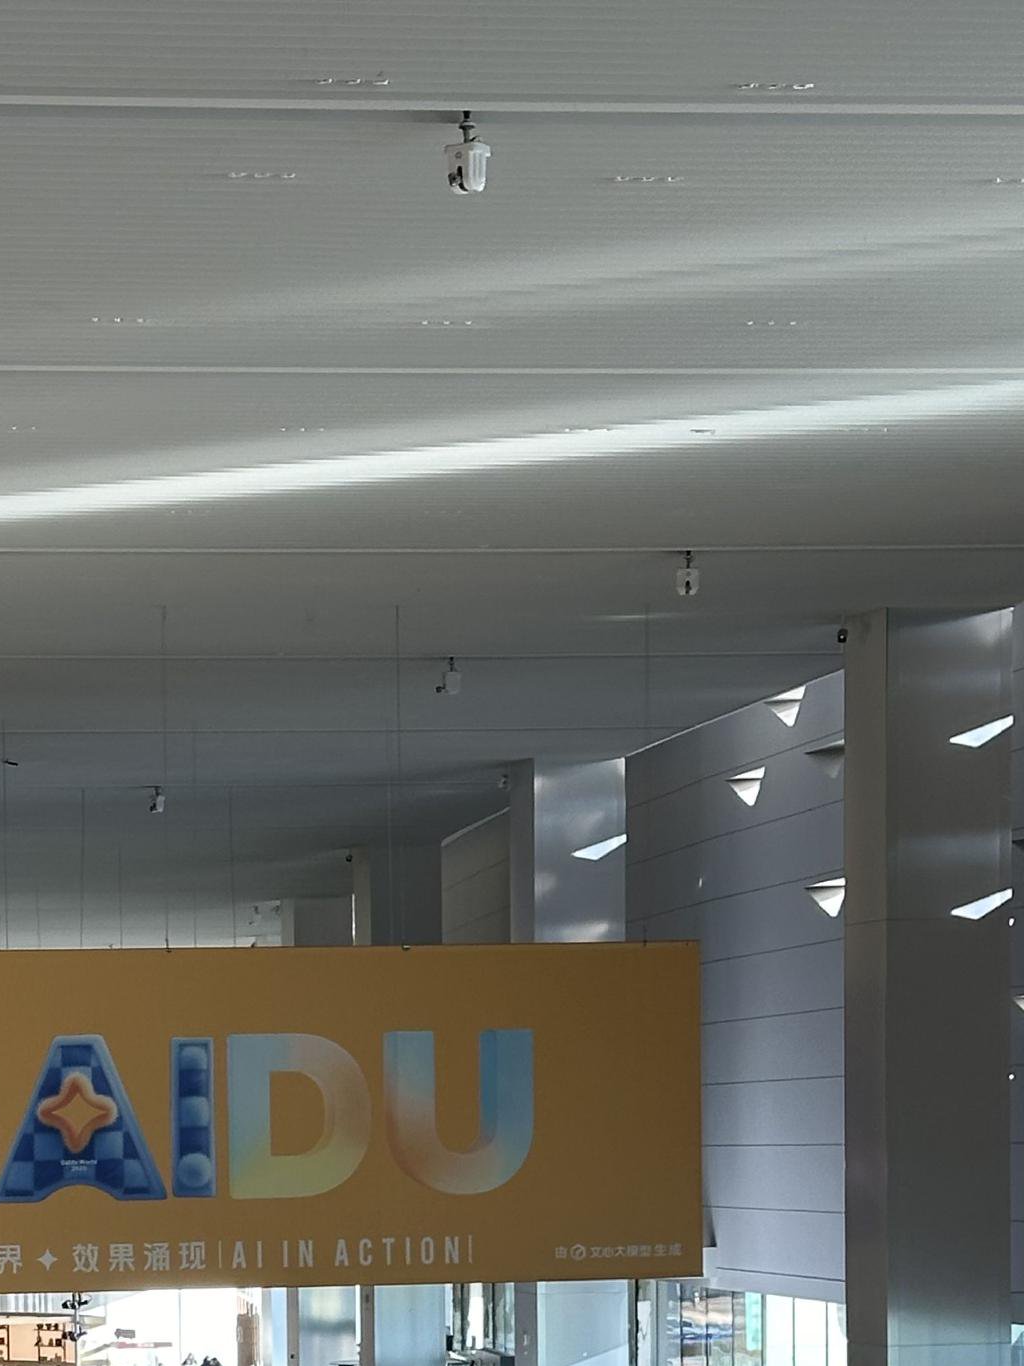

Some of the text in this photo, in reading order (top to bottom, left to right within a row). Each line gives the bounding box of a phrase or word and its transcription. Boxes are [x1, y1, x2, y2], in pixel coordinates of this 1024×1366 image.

[71, 1240, 208, 1275] 效果涌现
[232, 1235, 461, 1268] AI IN ACTION
